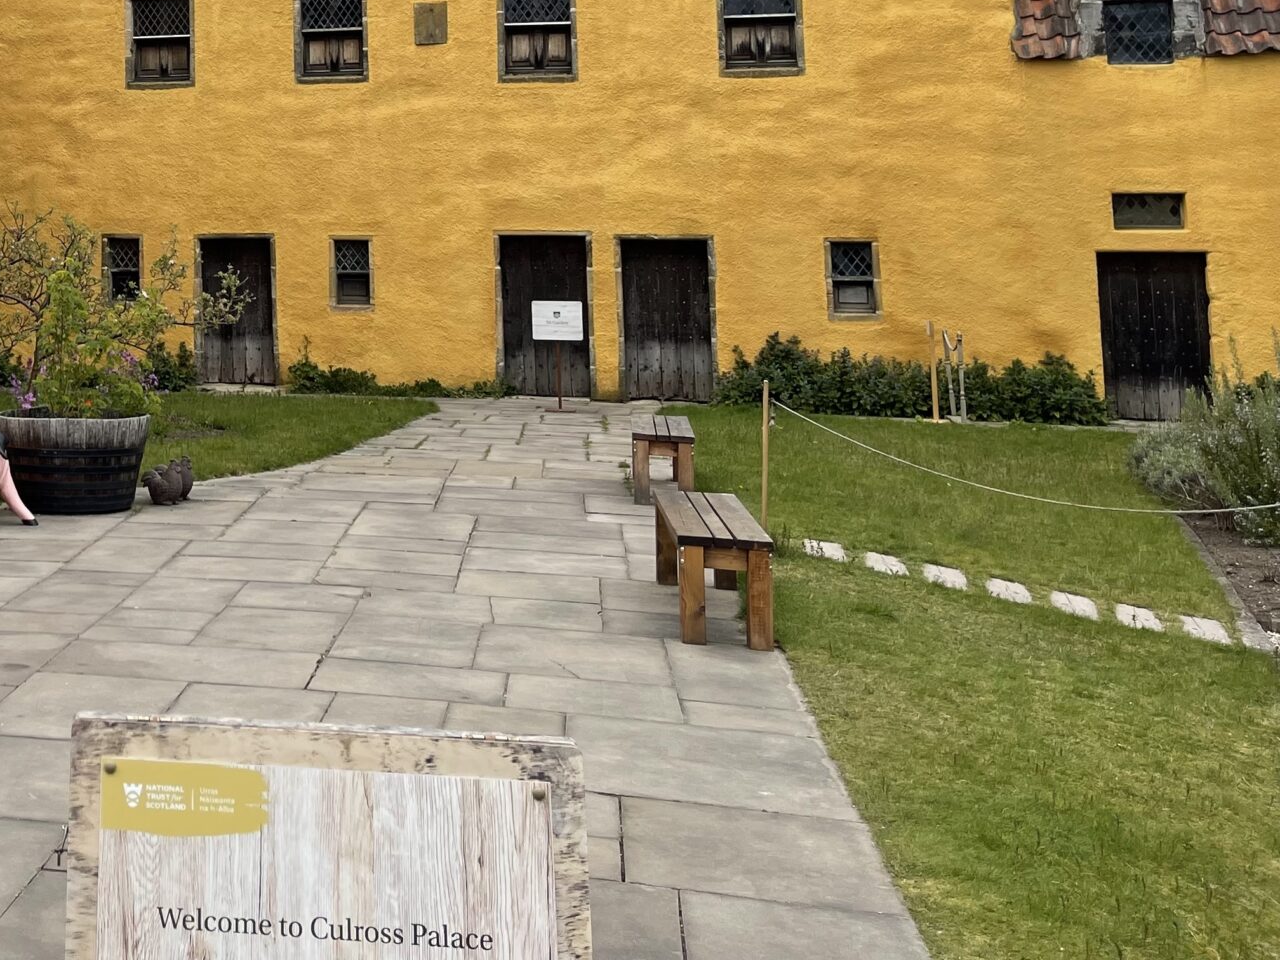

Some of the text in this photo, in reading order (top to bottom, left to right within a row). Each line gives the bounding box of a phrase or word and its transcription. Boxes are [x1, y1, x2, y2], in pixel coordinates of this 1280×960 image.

[146, 784, 184, 793] NATIONAL
[147, 793, 170, 801] TRUST
[145, 802, 186, 811] SCOTLAND
[157, 906, 494, 951] Welcome to Culross Palace
